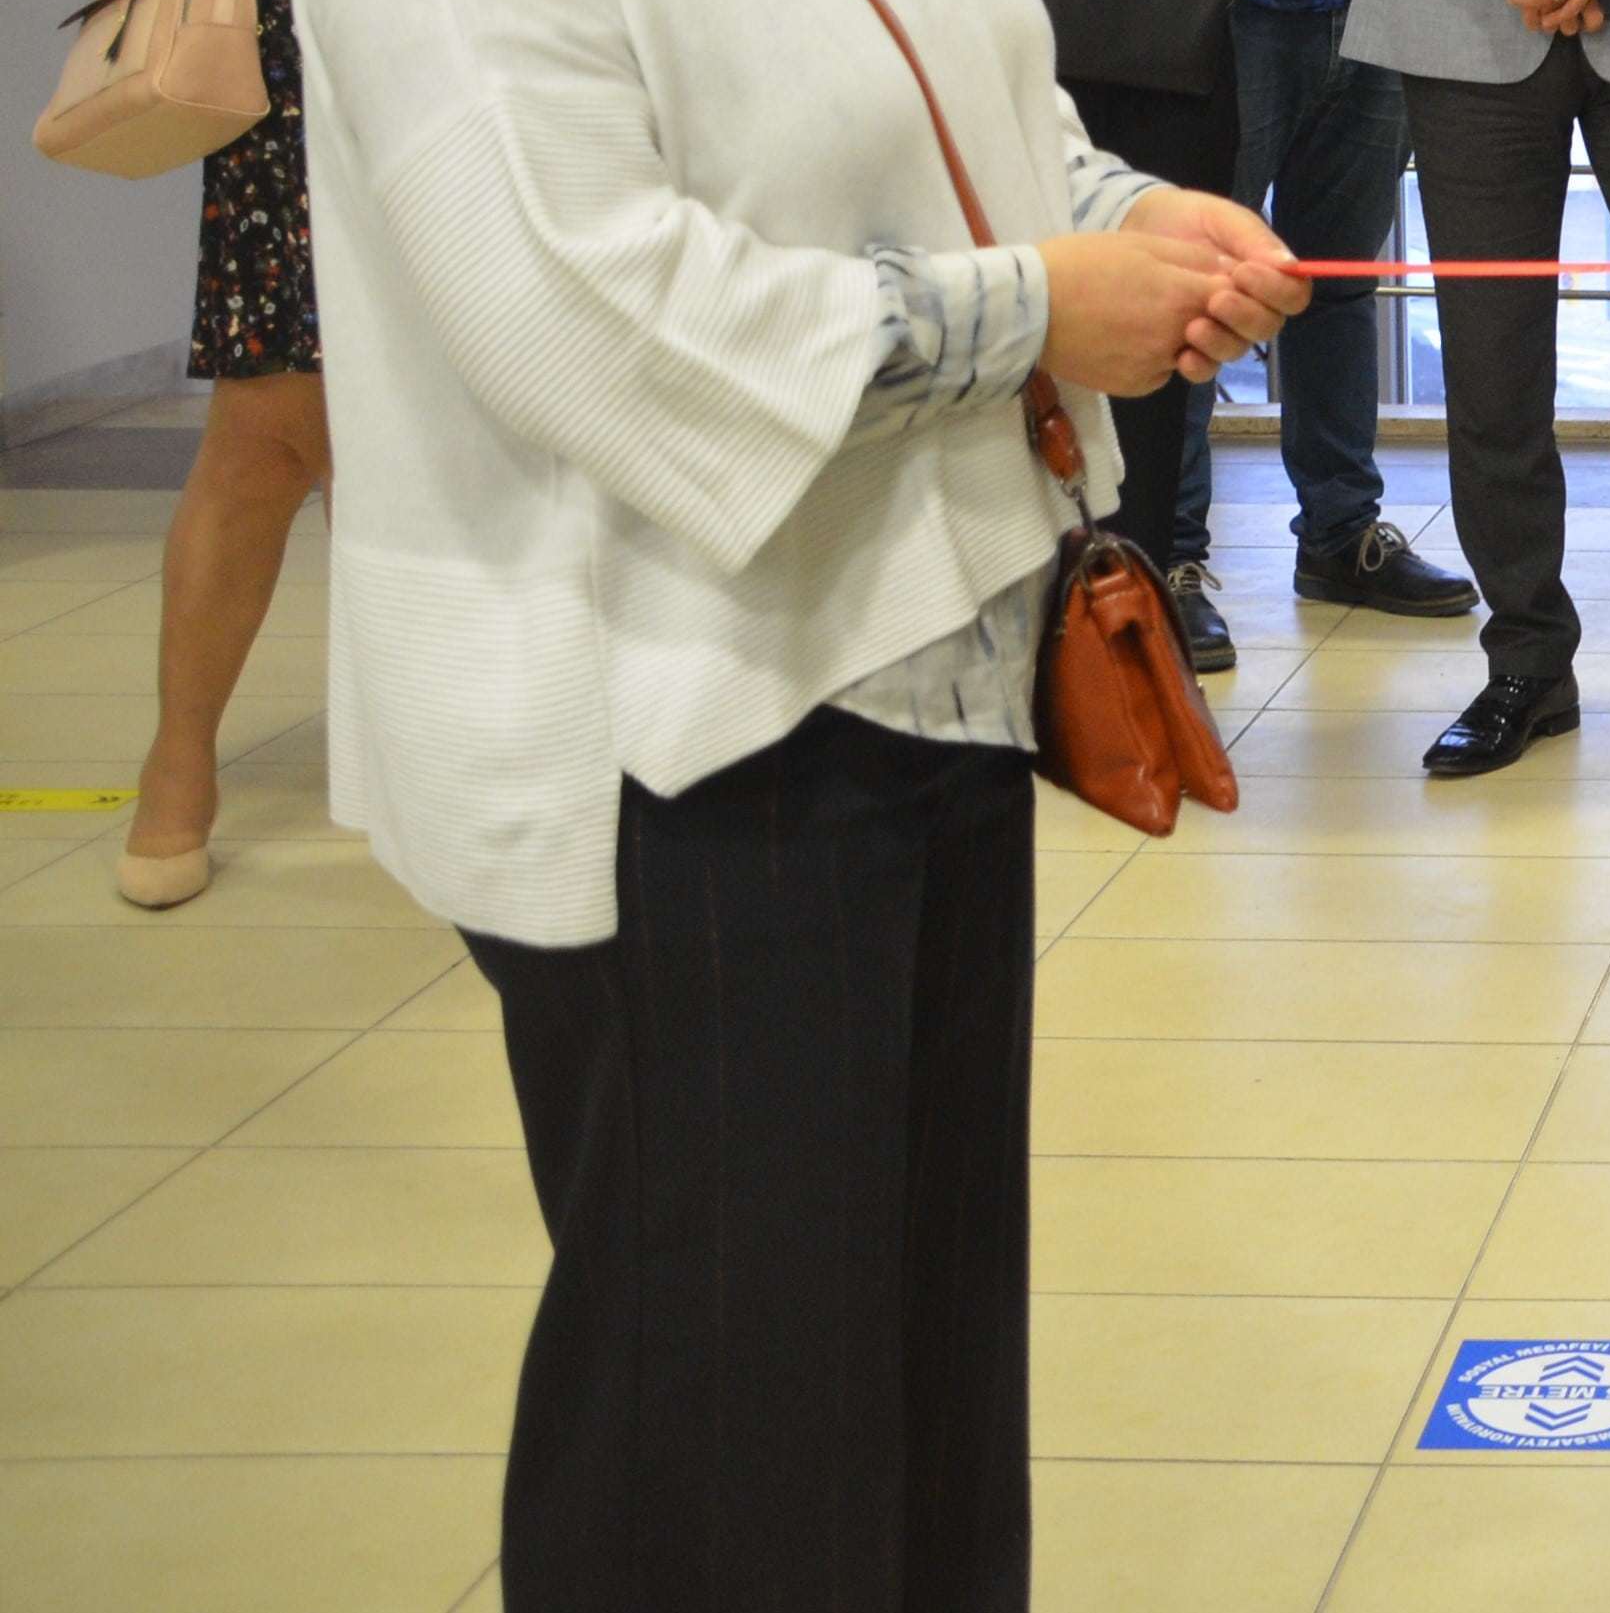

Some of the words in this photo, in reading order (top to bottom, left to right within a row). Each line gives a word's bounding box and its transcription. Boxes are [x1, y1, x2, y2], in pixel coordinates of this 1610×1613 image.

[1458, 1354, 1514, 1383] SOSYAL
[1516, 1342, 1610, 1358] MESAFEYİ
[1479, 1385, 1596, 1400] METRE
